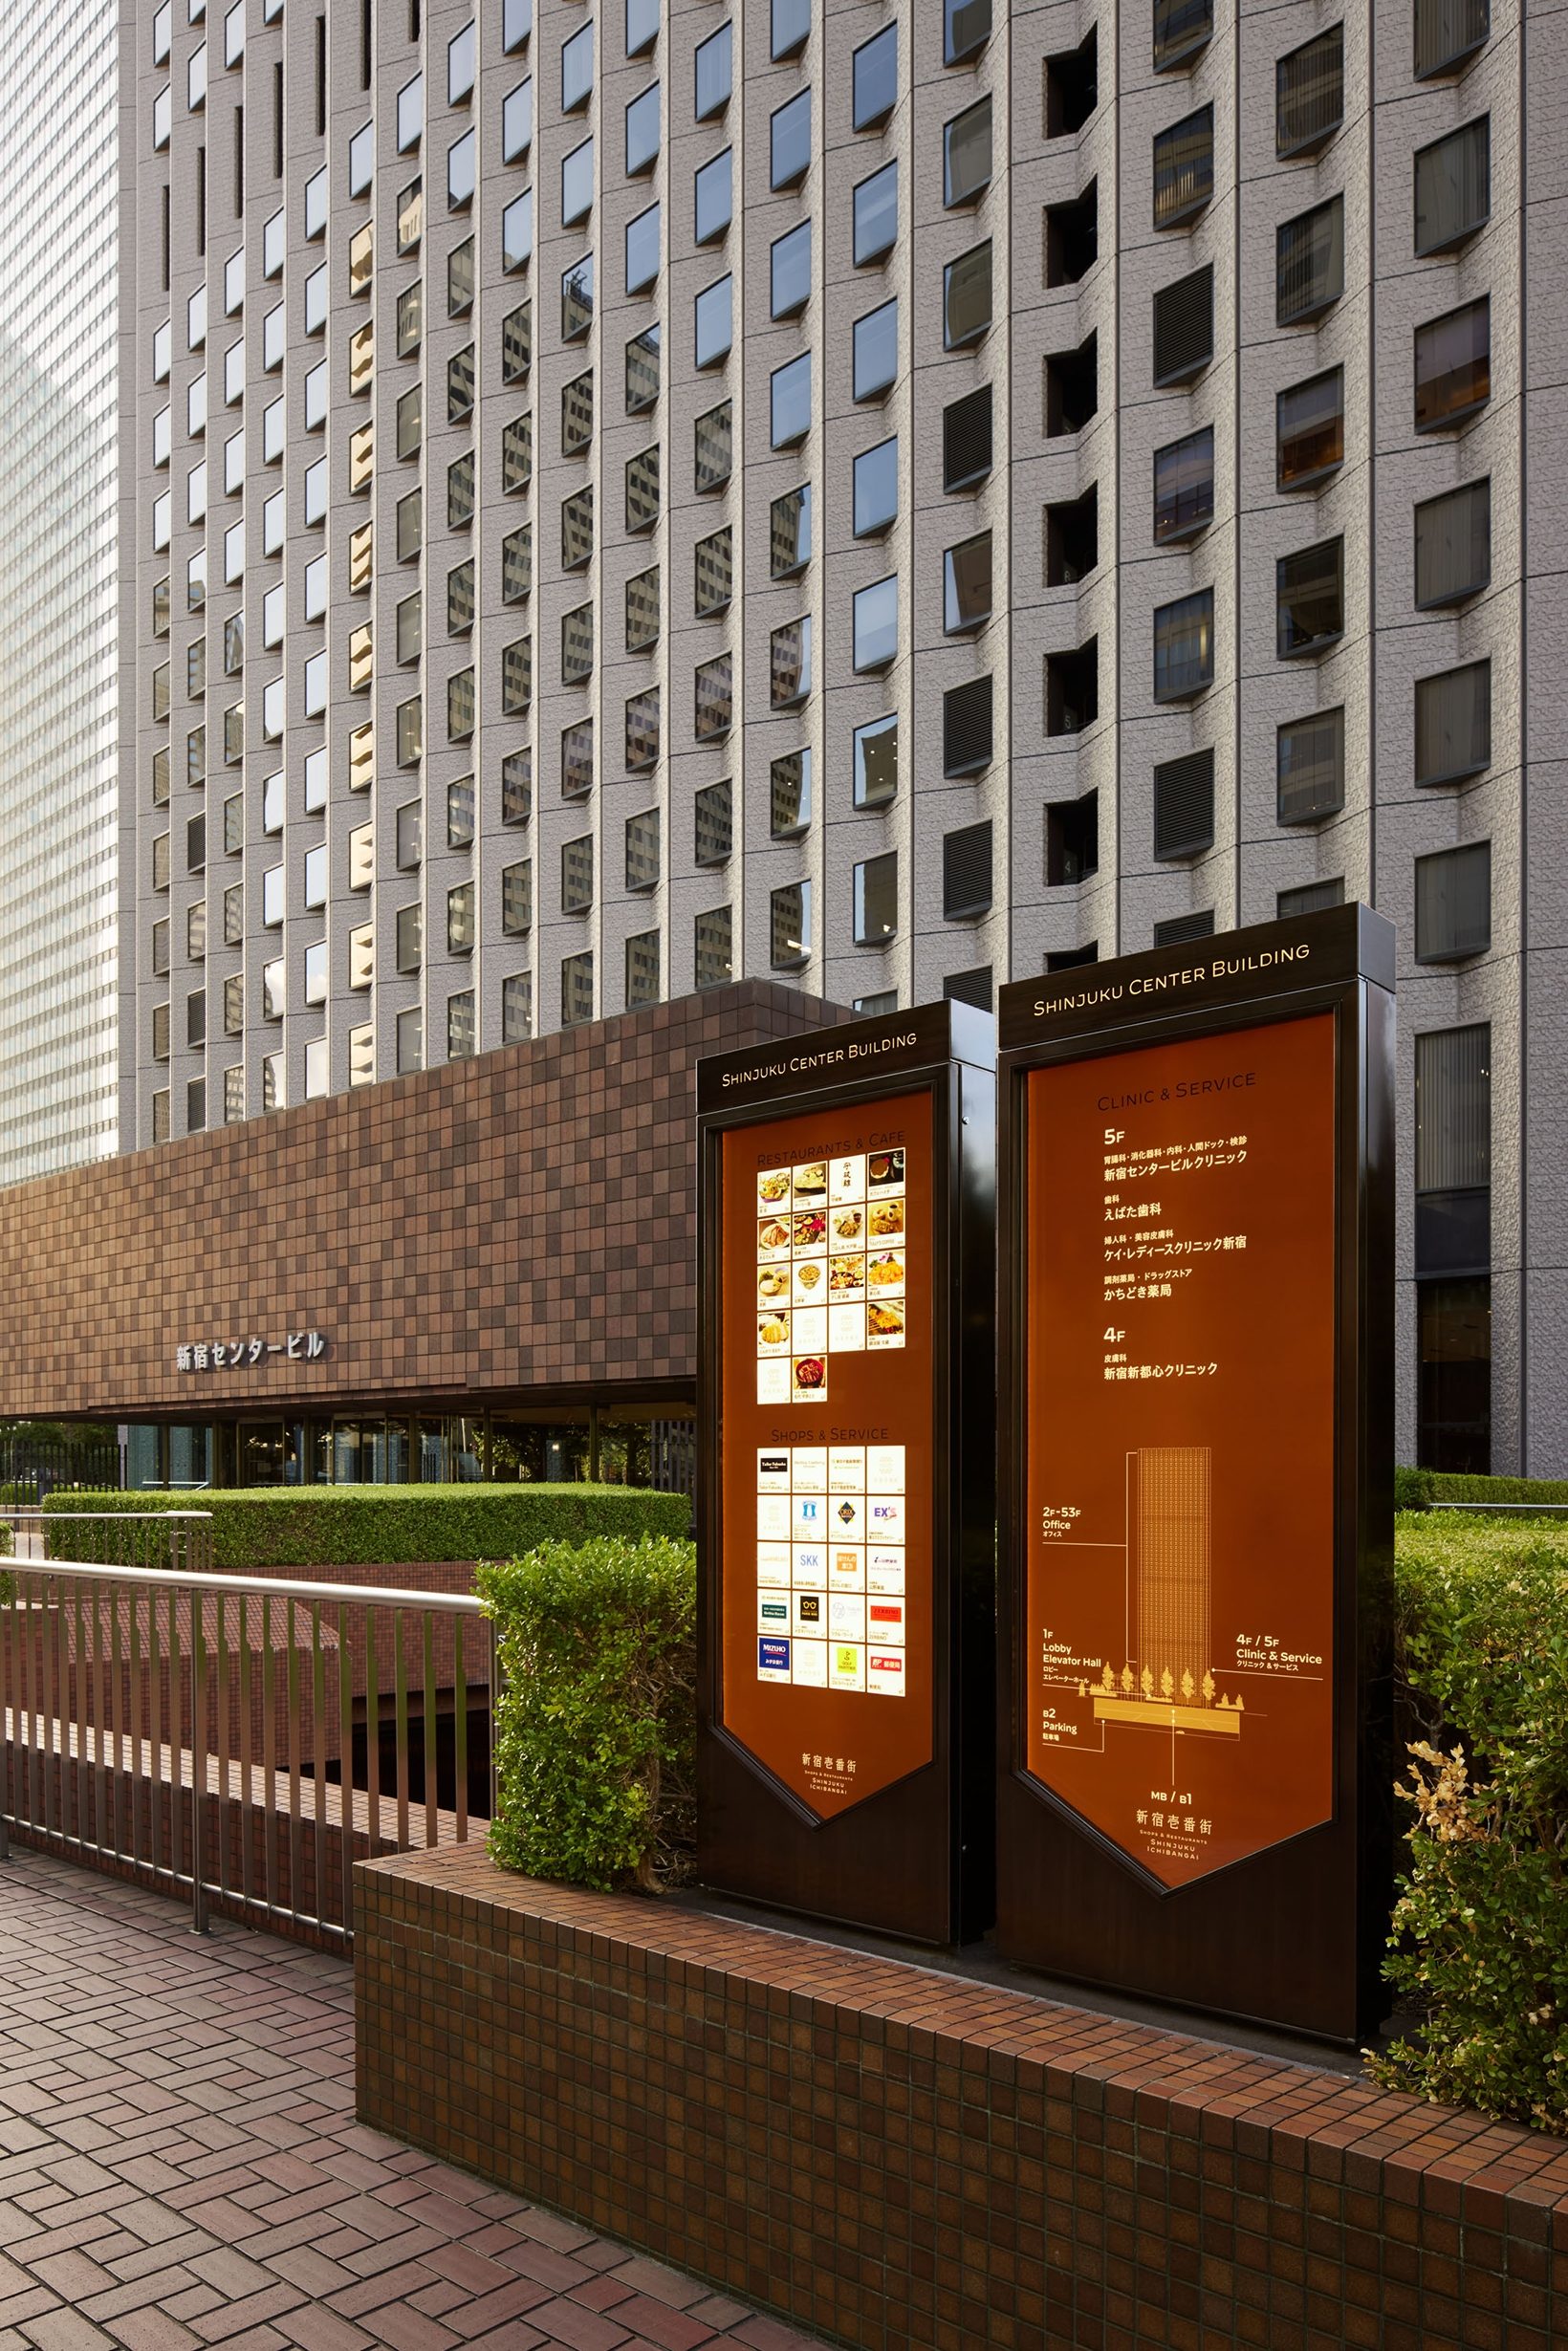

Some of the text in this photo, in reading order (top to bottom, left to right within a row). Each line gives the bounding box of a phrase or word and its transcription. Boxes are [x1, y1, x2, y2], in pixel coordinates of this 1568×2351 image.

[1034, 944, 1310, 1016] SHINJUKU CENTER BUILDING
[722, 1033, 917, 1087] SHINJUKU CENTER BUILDING
[1098, 1072, 1256, 1112] CLINIC & SERVICE
[1104, 1128, 1125, 1145] 5F
[757, 1139, 851, 1166] RESTAURANTS
[856, 1138, 863, 1149] &
[1103, 1149, 1248, 1182] 新宿センタービルクリニック
[1104, 1202, 1162, 1221] えばた歯科
[1103, 1283, 1172, 1301] かちどき薬局
[1103, 1327, 1126, 1342] 4F
[176, 1332, 325, 1371] 新宿センタービル
[1103, 1361, 1218, 1381] 新宿新都心クリニック
[772, 1427, 888, 1442] SHOPS & SERVICE
[1042, 1520, 1071, 1530] Office
[800, 1555, 818, 1566] SKK
[1043, 1628, 1054, 1639] 1F
[1236, 1633, 1252, 1645] 4F
[1264, 1636, 1279, 1647] 5F
[763, 1644, 787, 1653] MIZUHO
[1043, 1643, 1072, 1655] Lobby
[1043, 1654, 1101, 1667] Elevator Hall
[1236, 1648, 1322, 1665] Clinic & Service
[1236, 1660, 1265, 1669] クリニック
[1043, 1708, 1056, 1719] B2
[1043, 1721, 1078, 1735] Parking
[801, 1752, 857, 1774] 新宿壱番街
[810, 1784, 847, 1795] ICHIBANGAI
[812, 1777, 845, 1788] SHINJUKU
[1151, 1791, 1167, 1801] MB
[1179, 1794, 1192, 1805] B1
[1136, 1809, 1212, 1835] 新宿壱番街
[1150, 1839, 1195, 1852] SHINJUKU
[1147, 1846, 1199, 1861] ICHIBANGAI
